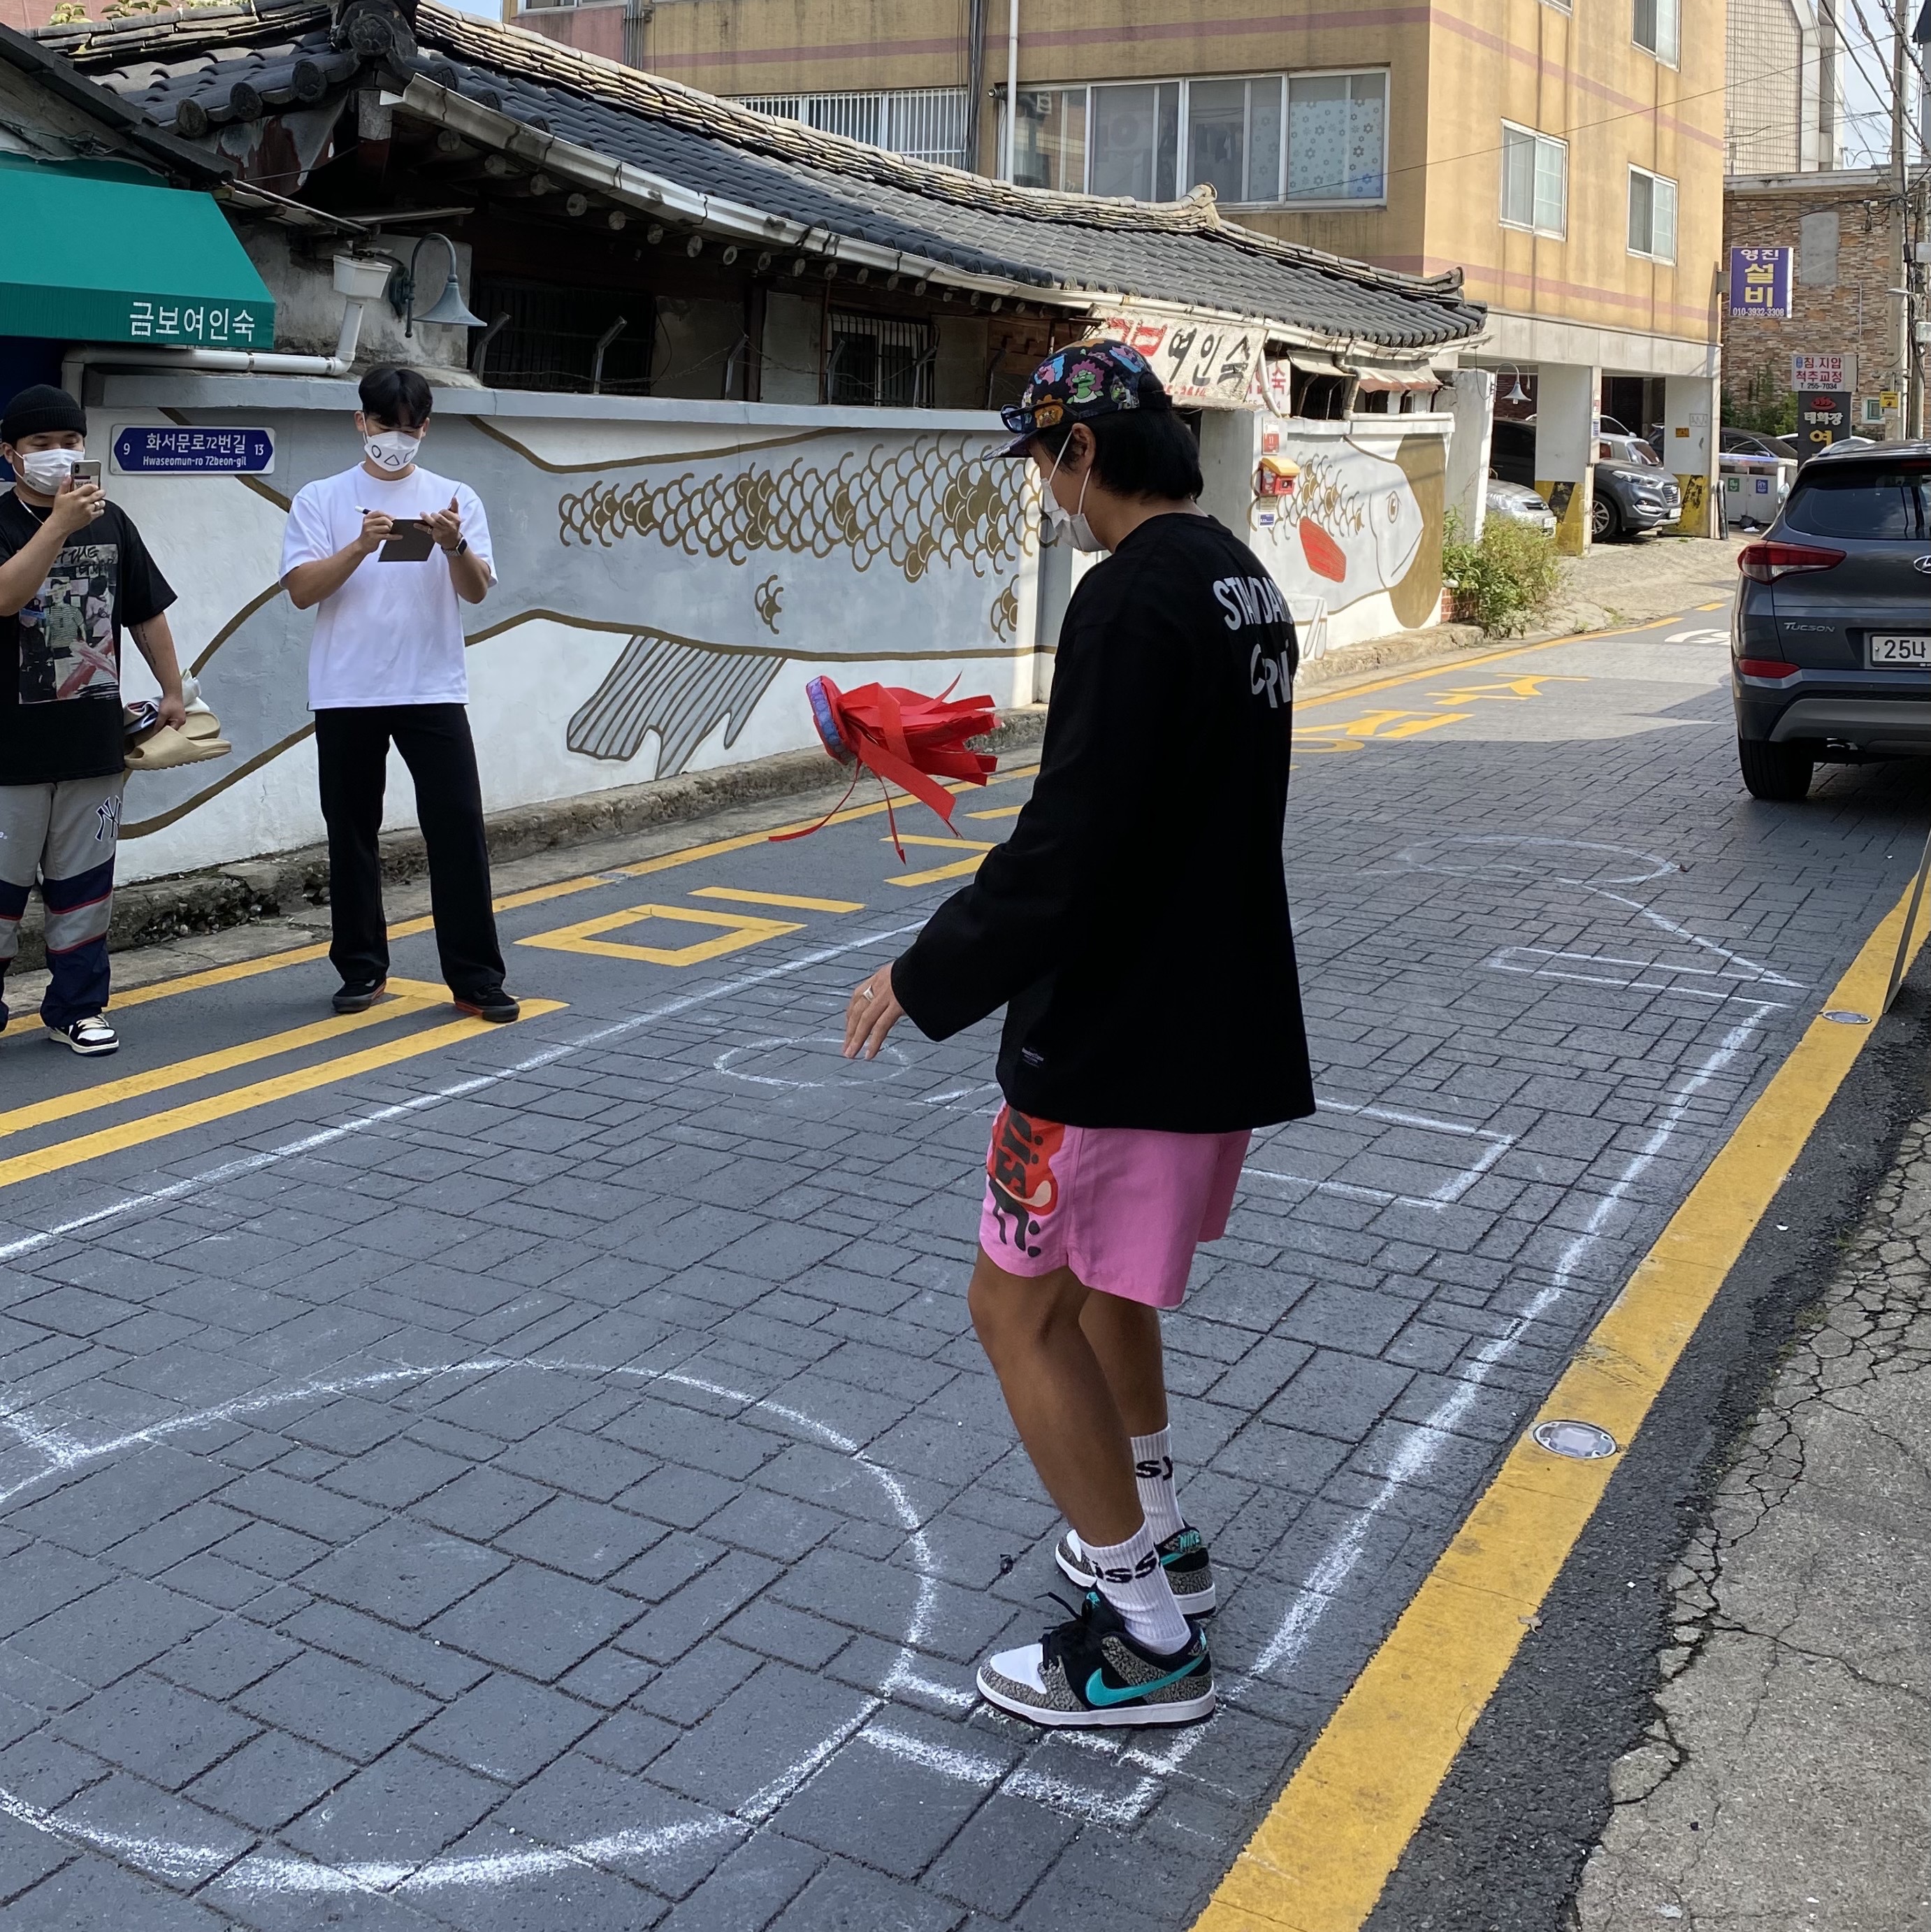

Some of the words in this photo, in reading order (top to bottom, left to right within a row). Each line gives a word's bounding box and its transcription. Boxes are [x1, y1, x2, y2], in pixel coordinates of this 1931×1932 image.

[1740, 249, 1779, 261] 영진
[1744, 263, 1774, 308] 설비
[1733, 307, 1785, 317] 010-3932-3308
[129, 301, 256, 343] 금보여인숙
[123, 442, 131, 455] 9
[145, 432, 246, 454] 화서문로72번길
[254, 444, 264, 455] 13
[143, 455, 203, 467] Hwaseomun-ro
[205, 456, 247, 468] 72beon-gil
